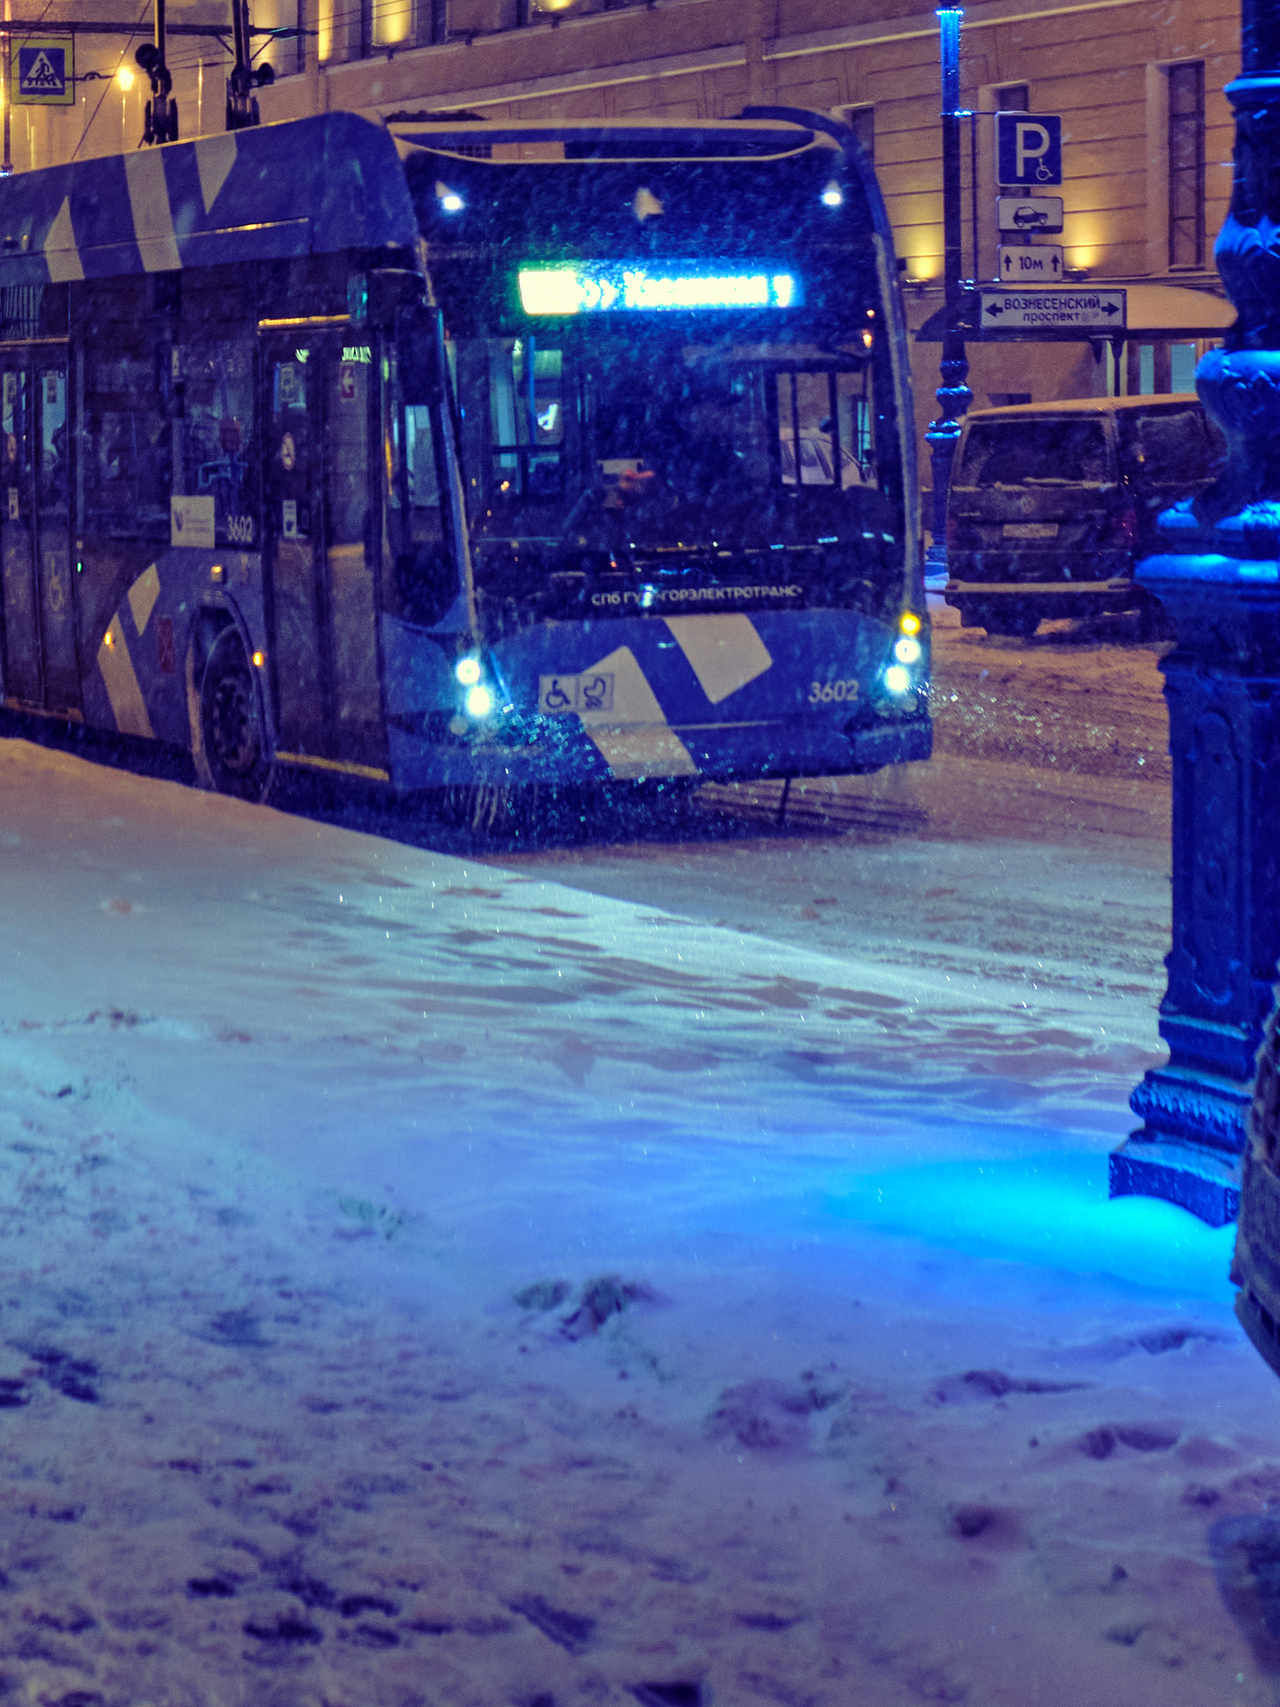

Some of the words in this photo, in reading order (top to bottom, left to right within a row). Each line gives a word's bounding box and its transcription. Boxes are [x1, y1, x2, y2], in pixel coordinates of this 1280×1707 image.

[1015, 122, 1050, 178] P
[1018, 255, 1044, 271] 10м
[1004, 295, 1101, 310] ВОЗНЕСЕНСКИЙ
[1022, 312, 1081, 324] проспект
[226, 515, 253, 543] 3602
[808, 680, 859, 703] 3602
